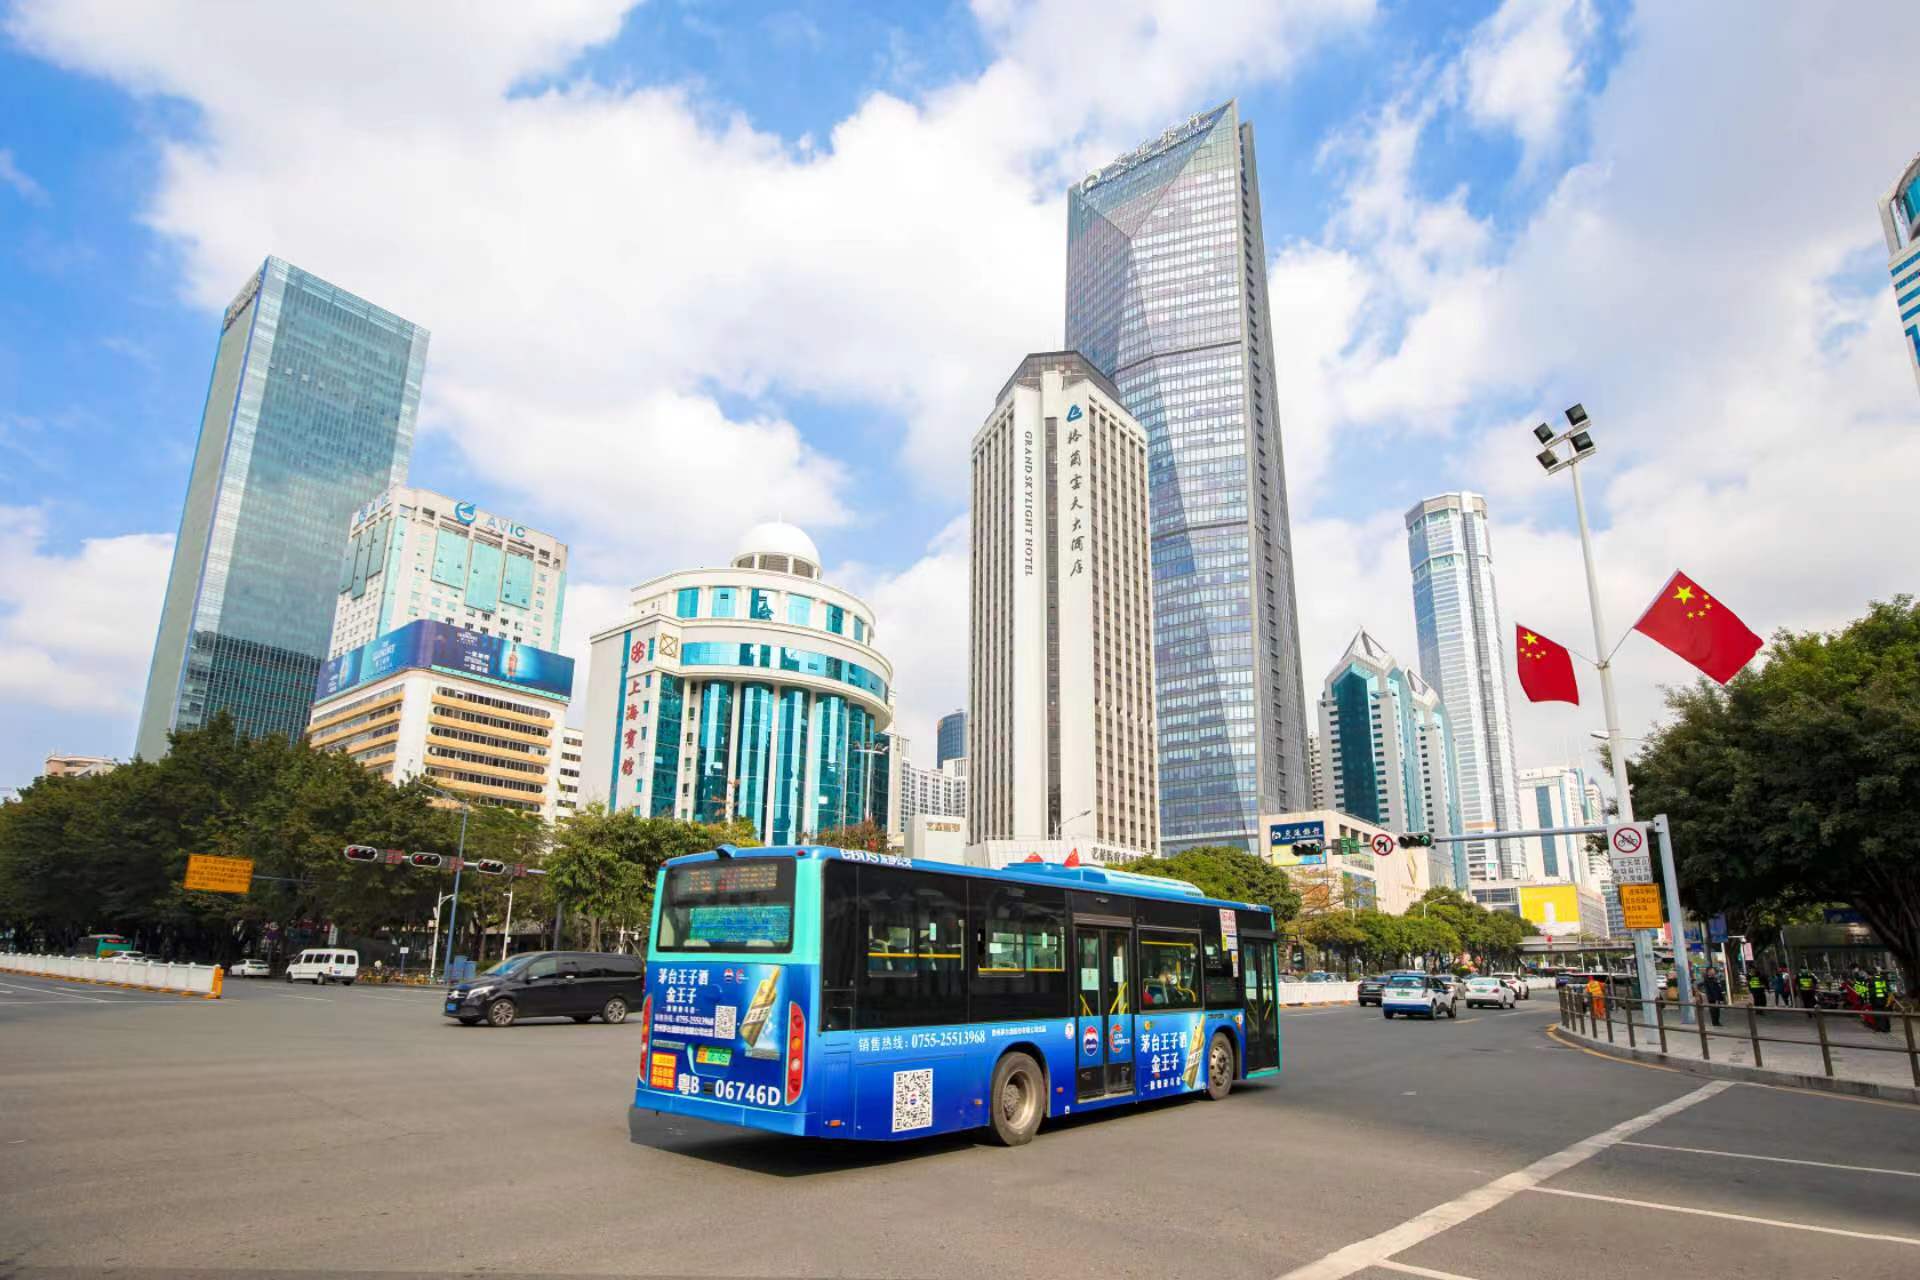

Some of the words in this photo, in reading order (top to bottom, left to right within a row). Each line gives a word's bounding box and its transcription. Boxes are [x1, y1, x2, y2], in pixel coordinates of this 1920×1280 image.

[1025, 431, 1033, 474] GRAND
[1025, 475, 1033, 535] SKYLIGHT
[486, 517, 527, 538] AVIC
[1025, 538, 1033, 576] HOTEL
[658, 968, 709, 985] 茅台王子酒
[666, 987, 696, 1004] 金王子
[1140, 1032, 1187, 1052] 茅台王子酒
[1151, 1052, 1179, 1073] 金王子
[714, 1079, 781, 1106] 06746D
